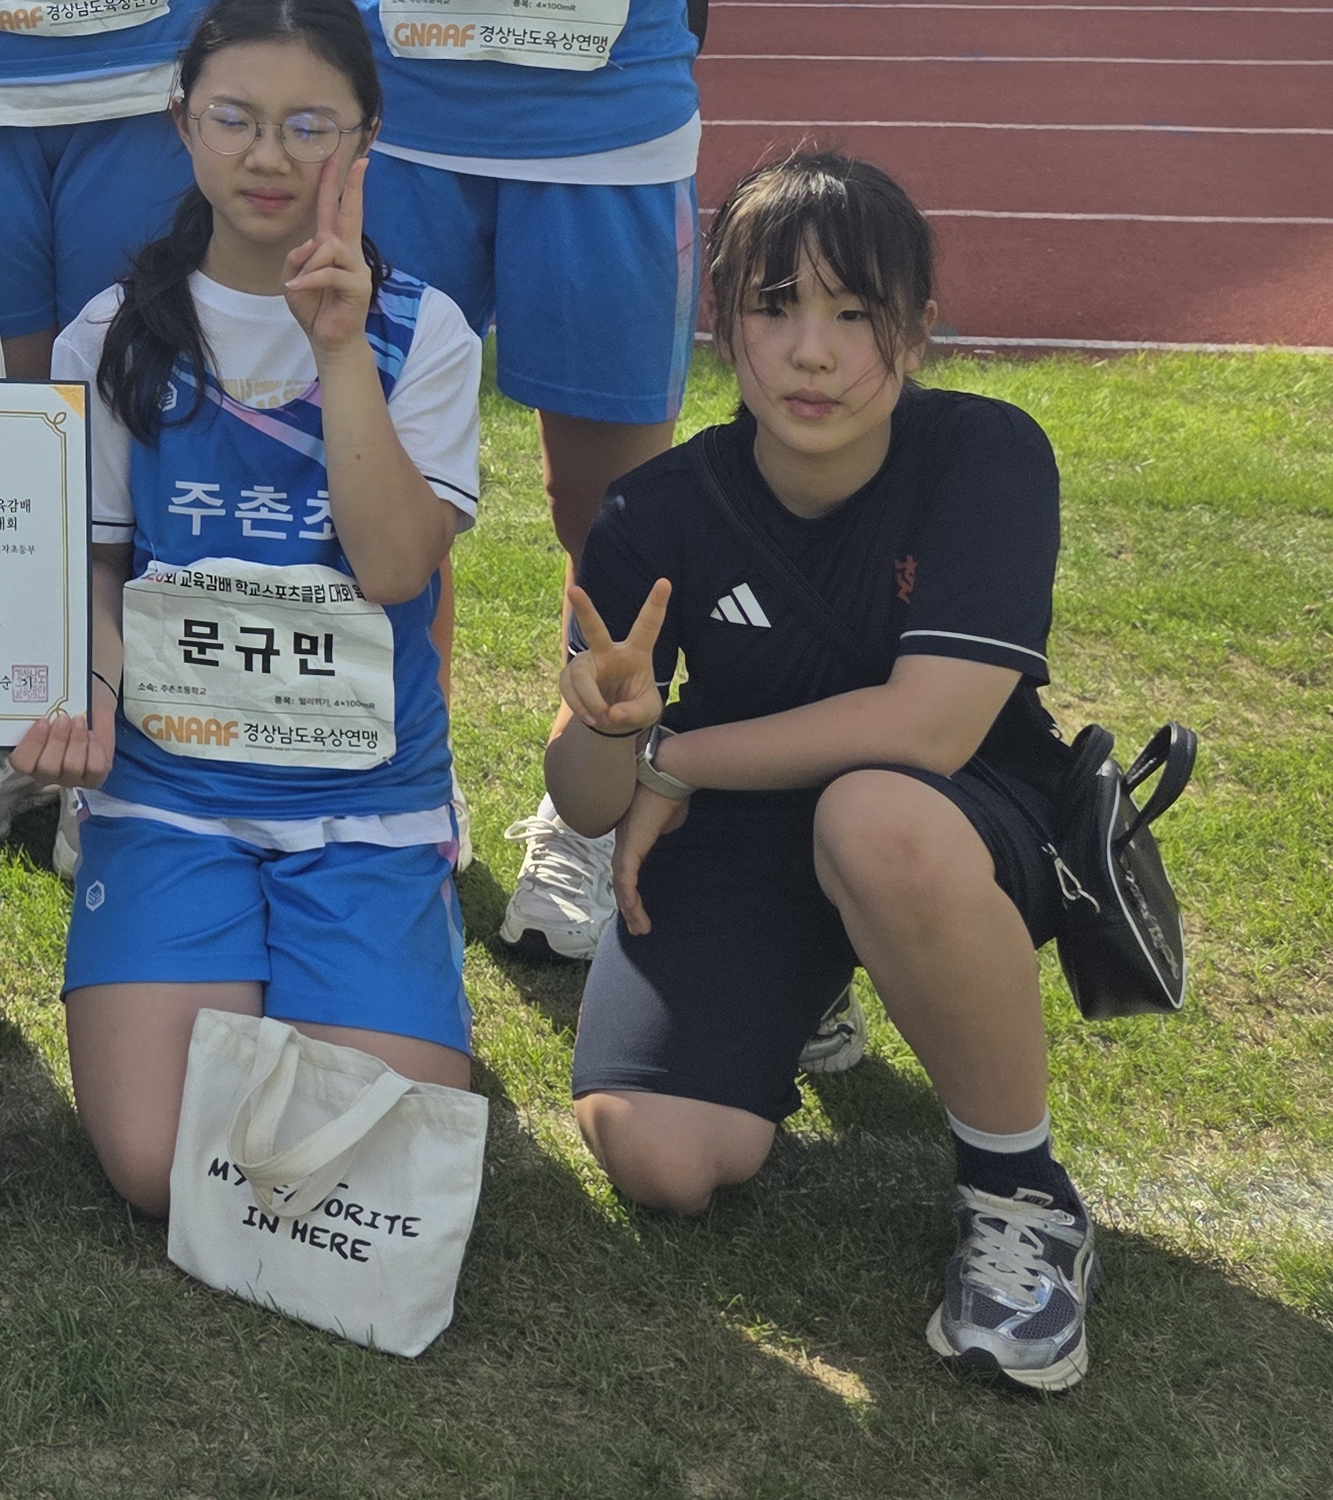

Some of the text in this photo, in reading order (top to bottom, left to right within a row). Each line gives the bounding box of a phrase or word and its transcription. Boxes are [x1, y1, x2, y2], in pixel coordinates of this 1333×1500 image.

[393, 22, 476, 47] GNAAF
[479, 25, 609, 54] 경상남도육상연맹
[180, 570, 353, 604] 교육감배 학교스포츠클럽 대회
[178, 619, 335, 676] 문규민
[141, 713, 239, 747] GNAAF
[244, 722, 378, 749] 경상남도육상연맹
[242, 1206, 372, 1263] IN HERE
